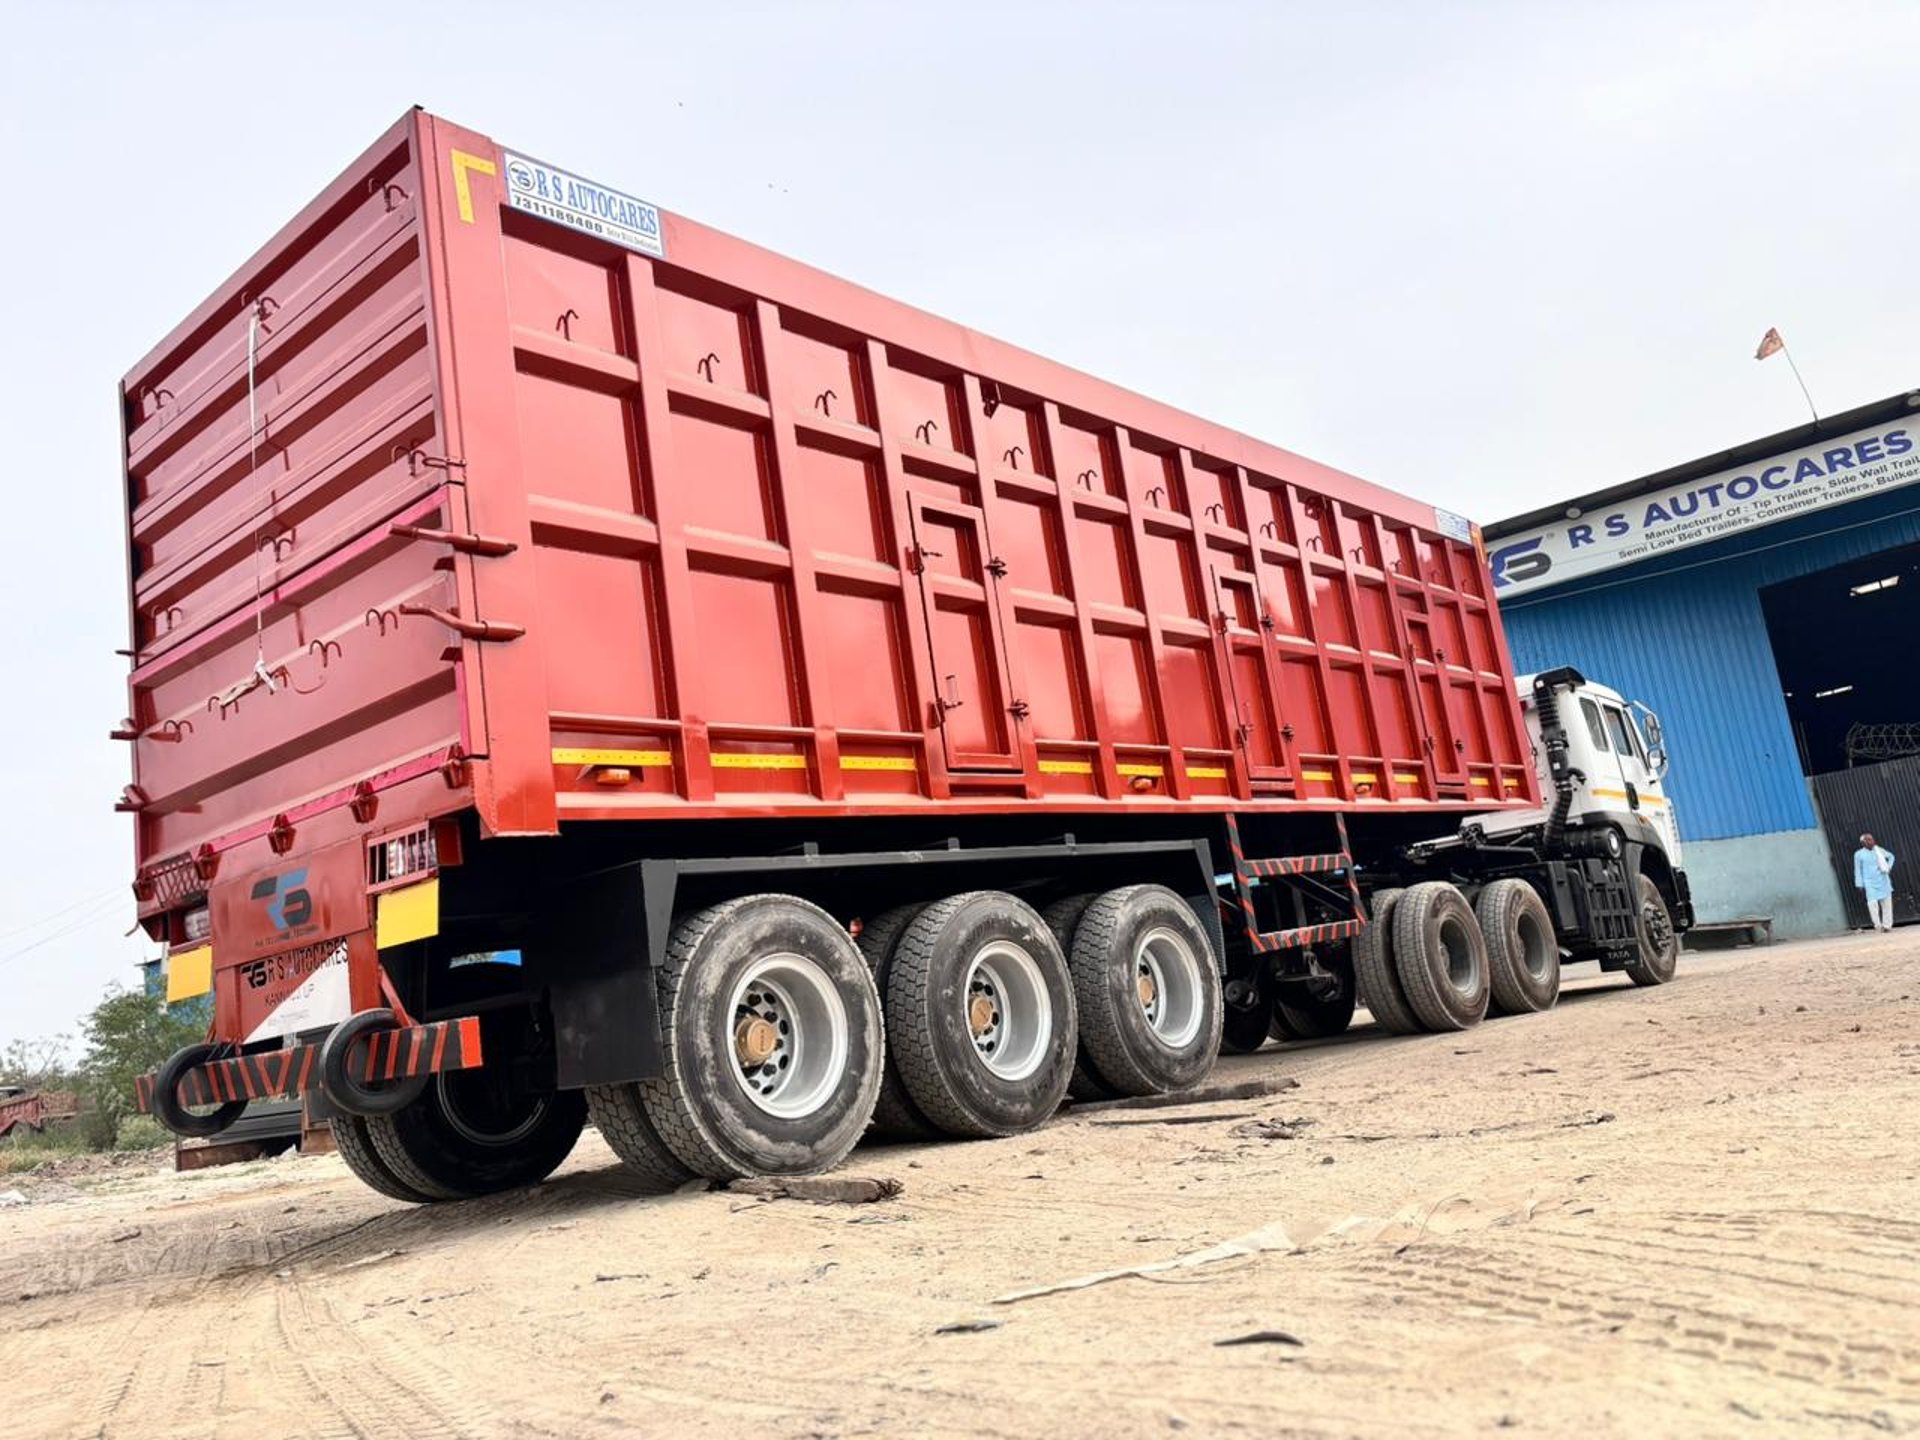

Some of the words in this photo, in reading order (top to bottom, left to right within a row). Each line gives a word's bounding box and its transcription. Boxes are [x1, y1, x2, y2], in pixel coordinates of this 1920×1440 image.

[535, 168, 549, 198] R
[552, 175, 563, 202] S
[567, 180, 658, 235] AUTOCARES
[1567, 524, 1595, 549] R
[1605, 513, 1630, 537] S
[1643, 430, 1913, 528] AUTOCARES
[1645, 513, 1723, 541] Manufacturer
[1726, 506, 1741, 517] Of
[1751, 498, 1772, 510] Tip
[1774, 484, 1826, 504] Trailers,
[1828, 475, 1857, 489] Side
[1859, 464, 1888, 479] Wall
[1890, 455, 1920, 470] Trail
[1618, 546, 1648, 560] Semi
[1650, 536, 1675, 551] Low
[1678, 529, 1702, 543] Bed
[1756, 497, 1818, 519] Container
[267, 958, 275, 983] R
[277, 956, 285, 980] S
[1607, 950, 1631, 960] TATA
